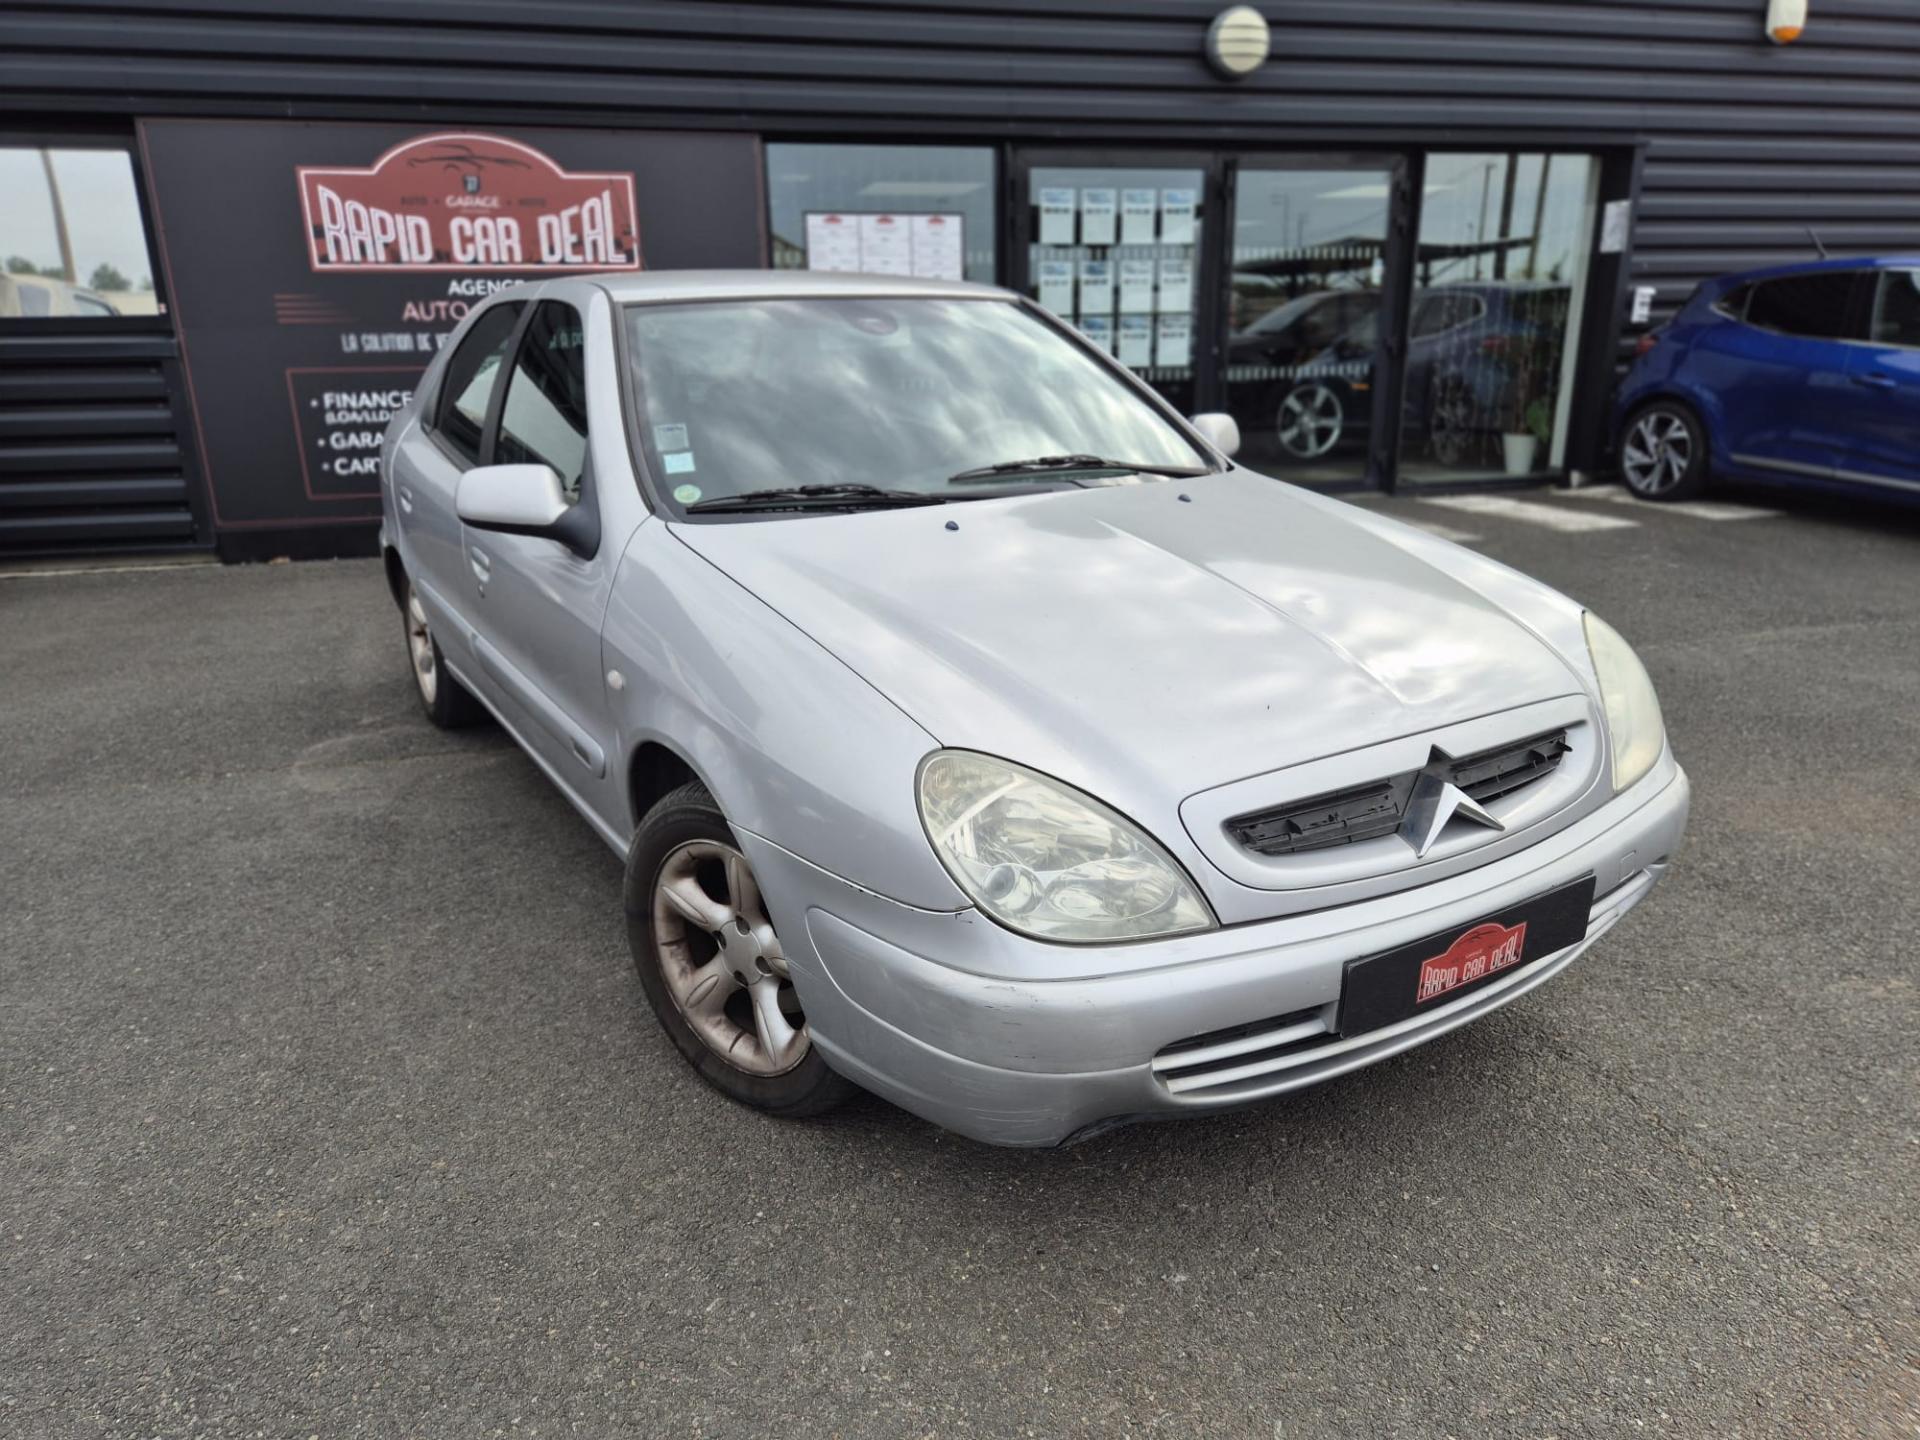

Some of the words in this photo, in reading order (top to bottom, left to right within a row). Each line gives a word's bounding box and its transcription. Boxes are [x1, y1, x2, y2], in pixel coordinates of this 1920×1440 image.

[317, 184, 433, 263] RAPID
[450, 216, 522, 263] CAR
[537, 189, 627, 263] DEAL
[1422, 966, 1458, 997] RAPID
[1462, 955, 1486, 981] CAR
[1490, 931, 1518, 971] DEAL
